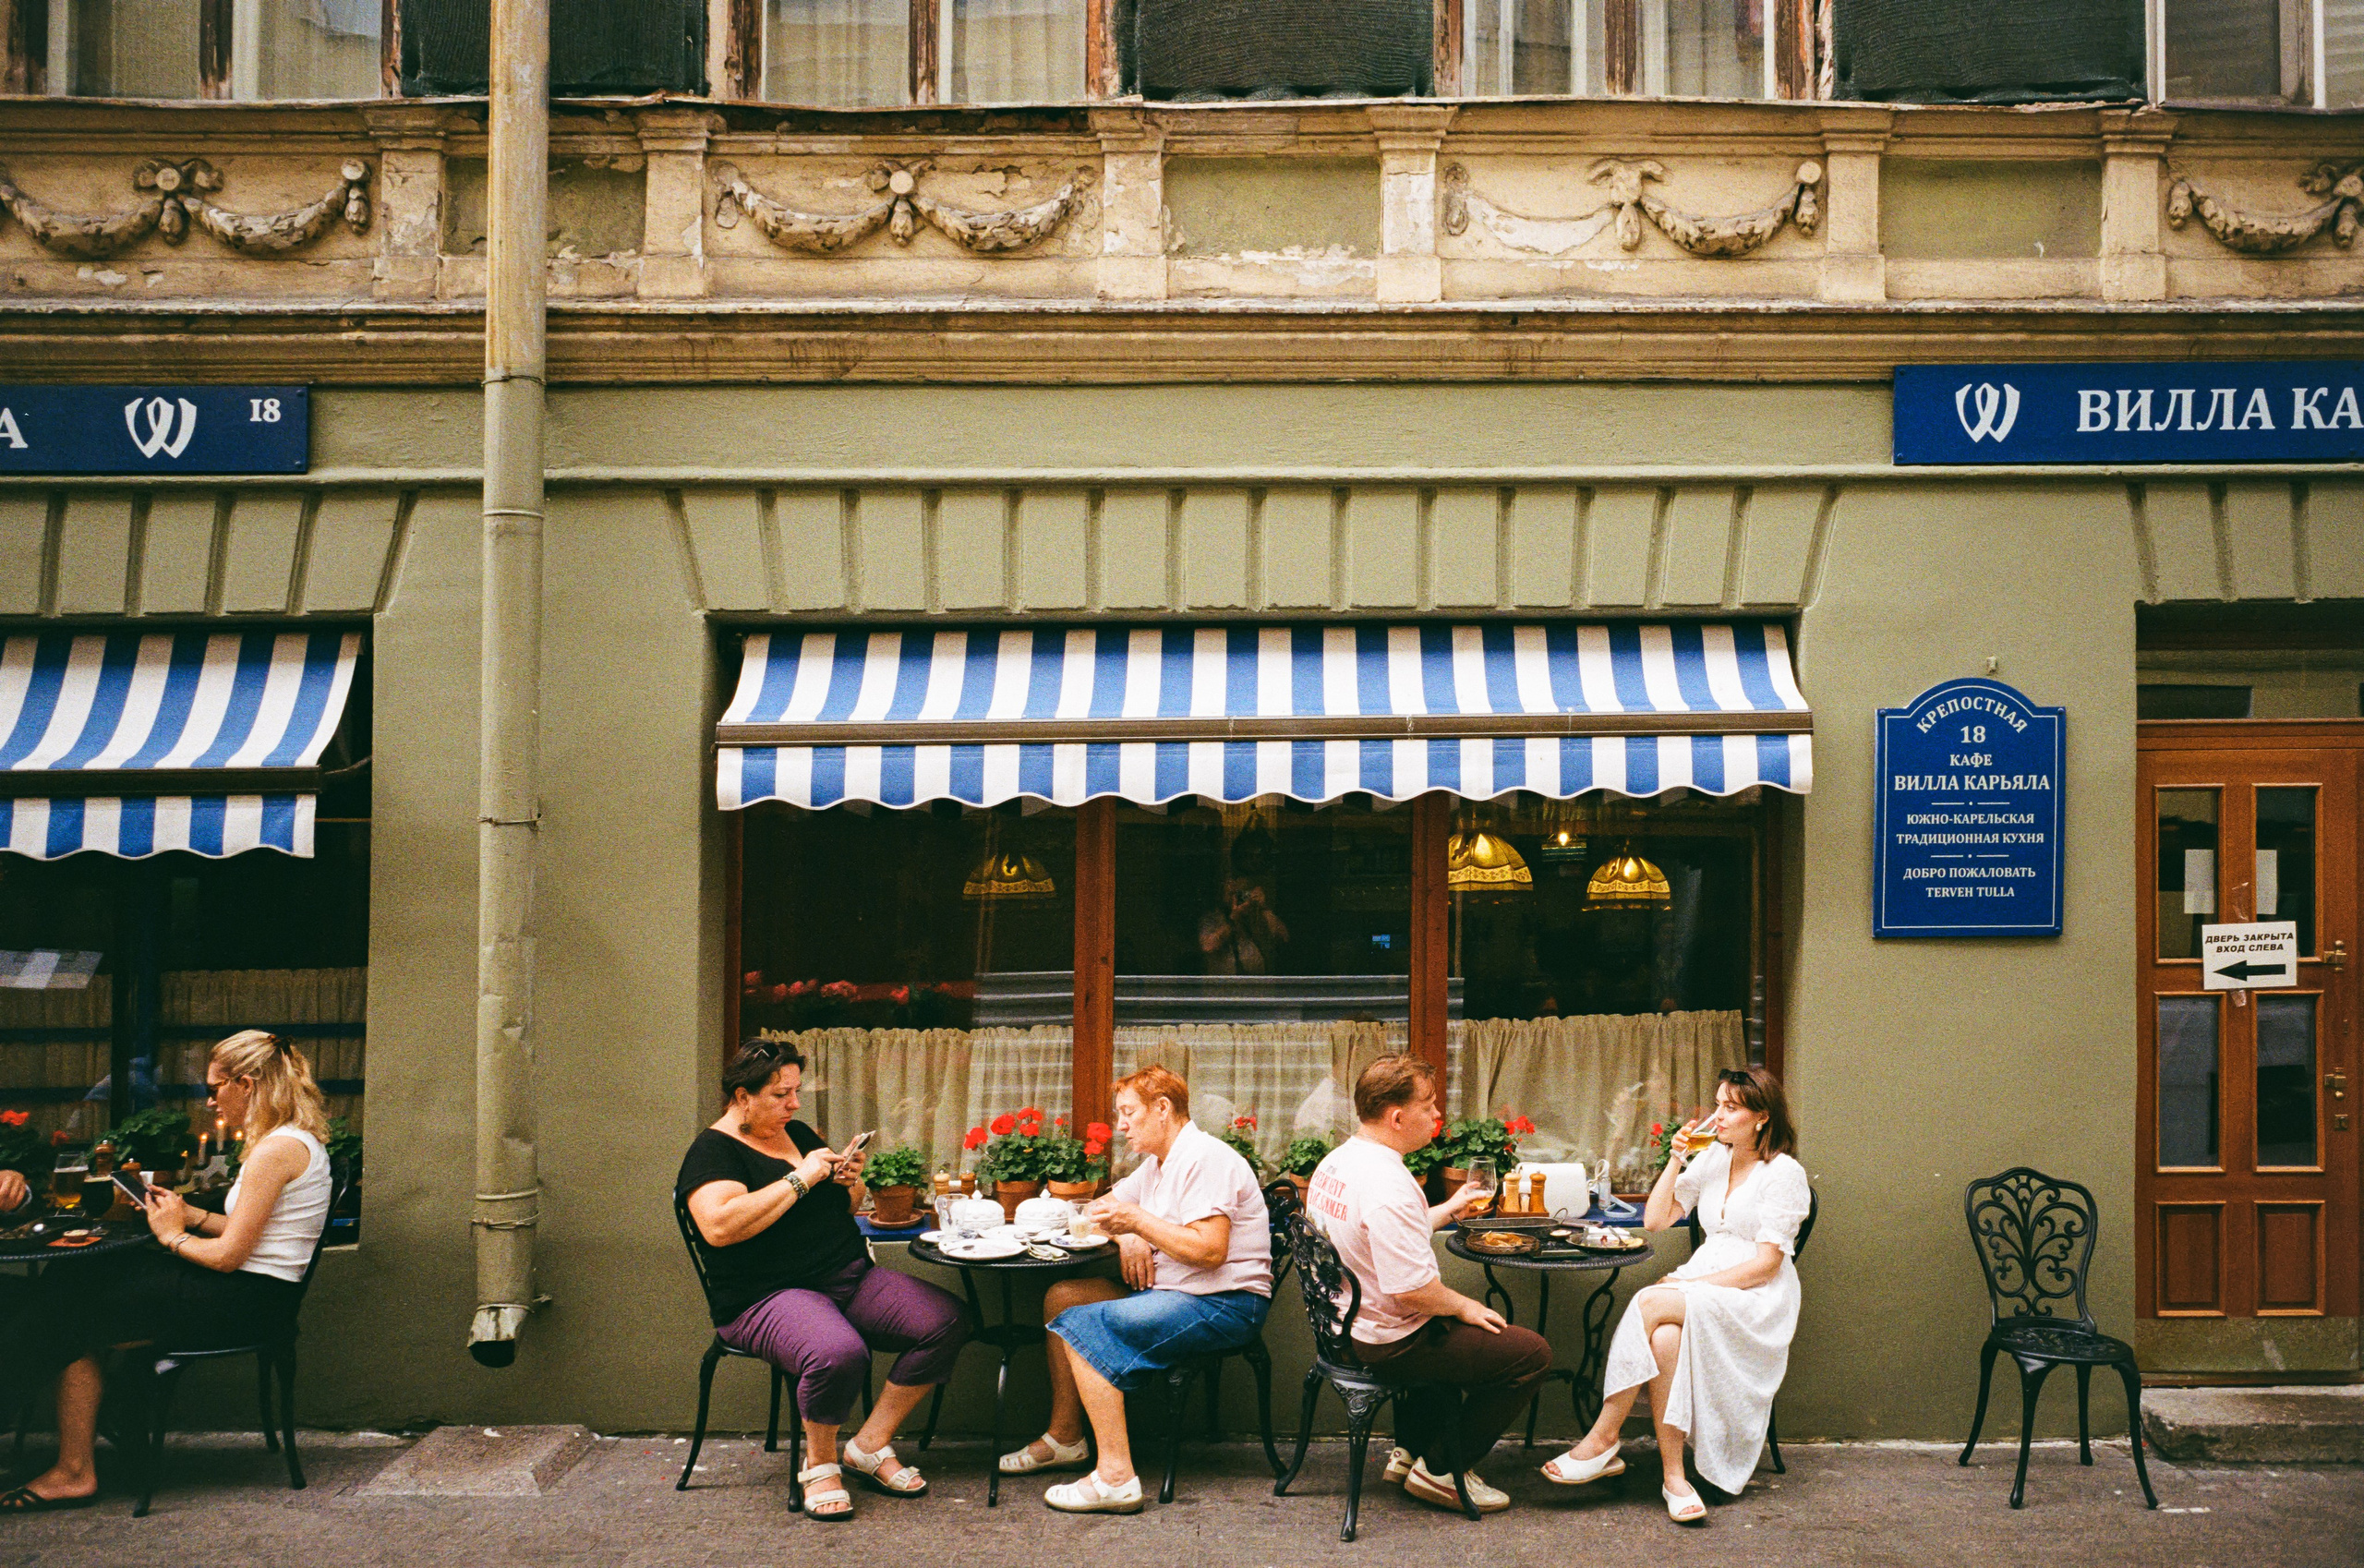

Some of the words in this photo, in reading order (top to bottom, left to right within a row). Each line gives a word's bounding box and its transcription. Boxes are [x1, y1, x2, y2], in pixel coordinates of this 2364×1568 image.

[249, 398, 282, 423] 18
[2076, 388, 2276, 432] ВИЛЛА
[2290, 387, 2364, 429] КА
[1915, 695, 2029, 734] КРЕПОСТНАЯ
[1960, 725, 1986, 743] 18
[1949, 752, 1993, 768] КАФЕ
[1894, 775, 1960, 790] ВИЛЛА
[1963, 774, 2050, 790] КАРЬЯЛА
[1906, 813, 2035, 825] ЮЖНО-КАРЕЛЬСКАЯ
[1896, 833, 1999, 846] ТРАДИЦИОННАЯ
[2002, 833, 2044, 844] КУХНЯ
[1902, 867, 1947, 880] ДОБРО
[1948, 867, 2036, 878] ПОЖАЛОВАТЬ
[1925, 887, 1973, 898] TERVEH
[1976, 887, 2015, 898] TULLA
[2205, 935, 2240, 944] ДВЕРЬ
[2243, 932, 2294, 941] ЗАКРЫТА
[2216, 945, 2245, 954] ВХОД
[2249, 943, 2284, 951] СЛЕВА
